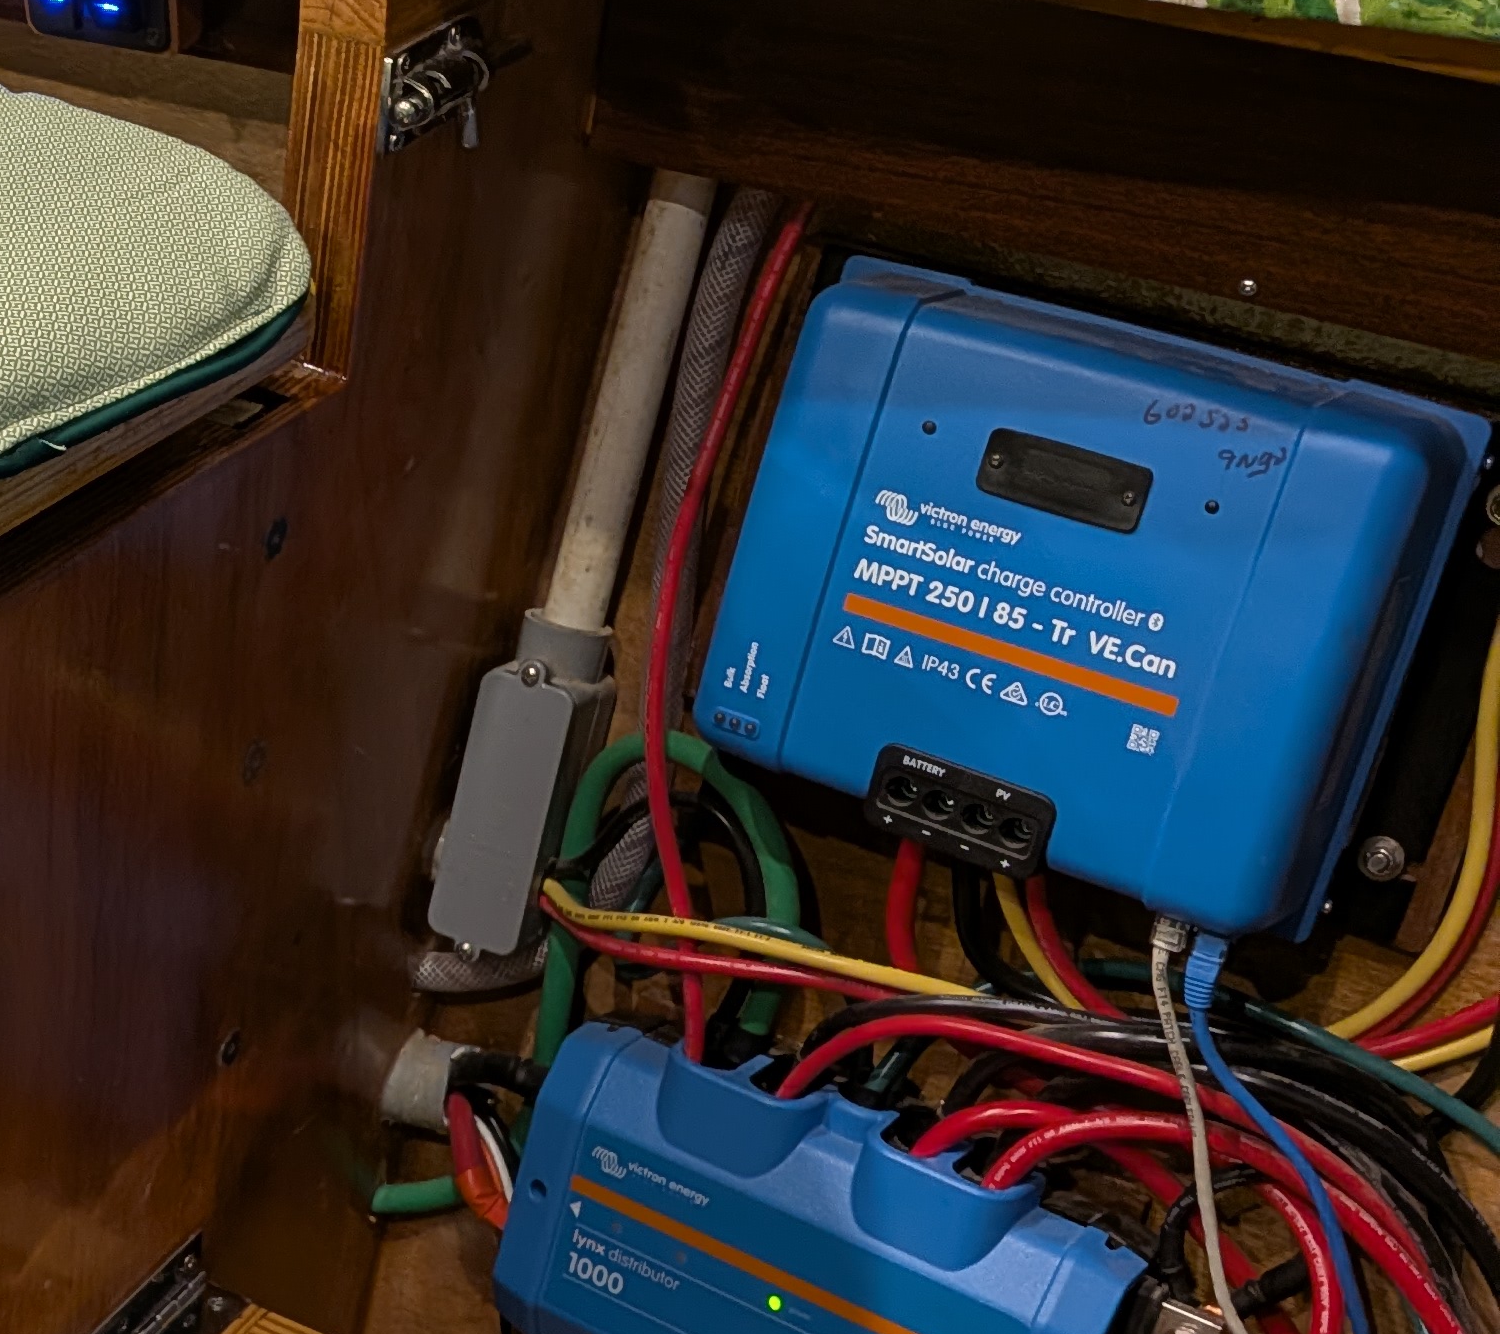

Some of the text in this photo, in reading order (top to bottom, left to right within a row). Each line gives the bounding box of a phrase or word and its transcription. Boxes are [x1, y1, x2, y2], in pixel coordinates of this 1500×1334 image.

[920, 502, 1022, 546] victron energy
[864, 525, 1145, 627] SmartSolar charge controller
[853, 558, 924, 596] MPPT
[925, 581, 974, 613] 250
[993, 602, 1028, 630] 85
[1051, 618, 1076, 646] Tr
[1089, 630, 1177, 679] VE.Can
[739, 641, 759, 694] Absorption
[756, 674, 769, 699] Float
[921, 654, 960, 680] IP43
[903, 755, 946, 777] BATTERY
[995, 788, 1011, 801] PV
[628, 1161, 710, 1207] victron energy
[568, 1251, 624, 1296] 1000
[572, 1228, 681, 1292] lynx distributor
